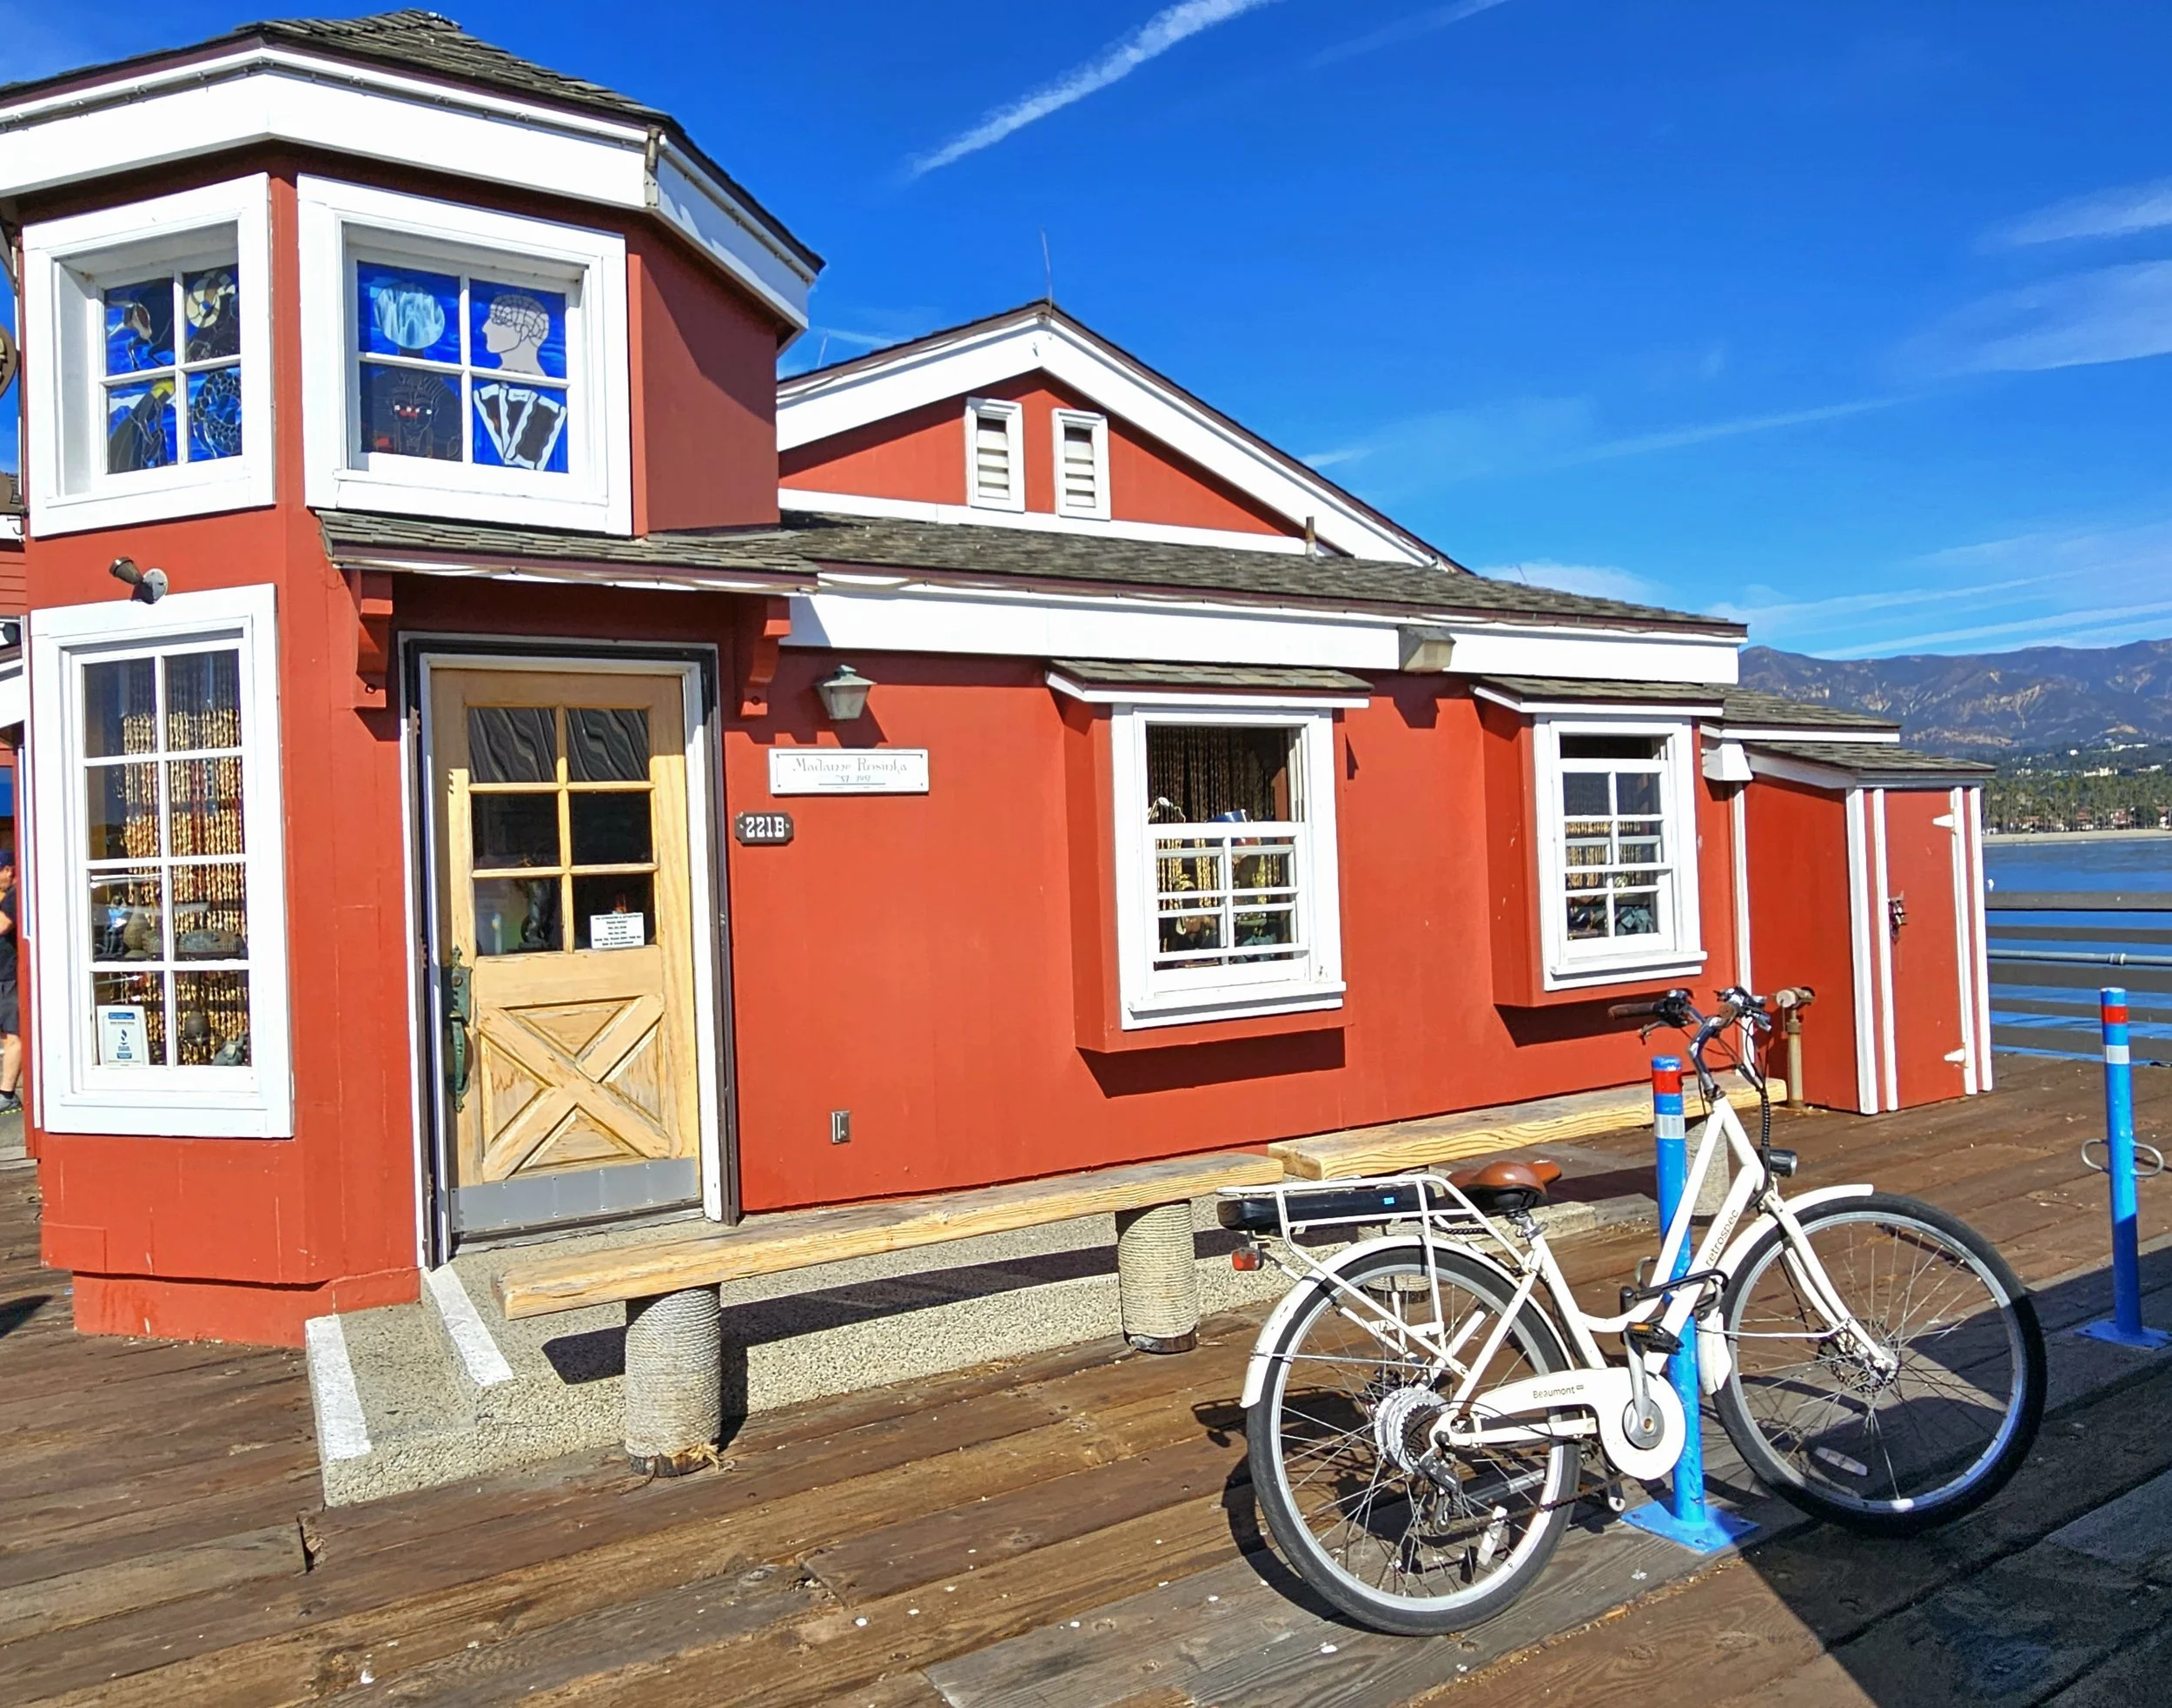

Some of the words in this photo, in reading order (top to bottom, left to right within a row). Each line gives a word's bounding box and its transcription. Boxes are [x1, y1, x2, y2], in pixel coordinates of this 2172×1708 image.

[792, 758, 851, 772] Madame
[745, 816, 785, 838] 221B
[1705, 1209, 1738, 1267] retrospec
[1533, 1386, 1575, 1399] Beaumont
